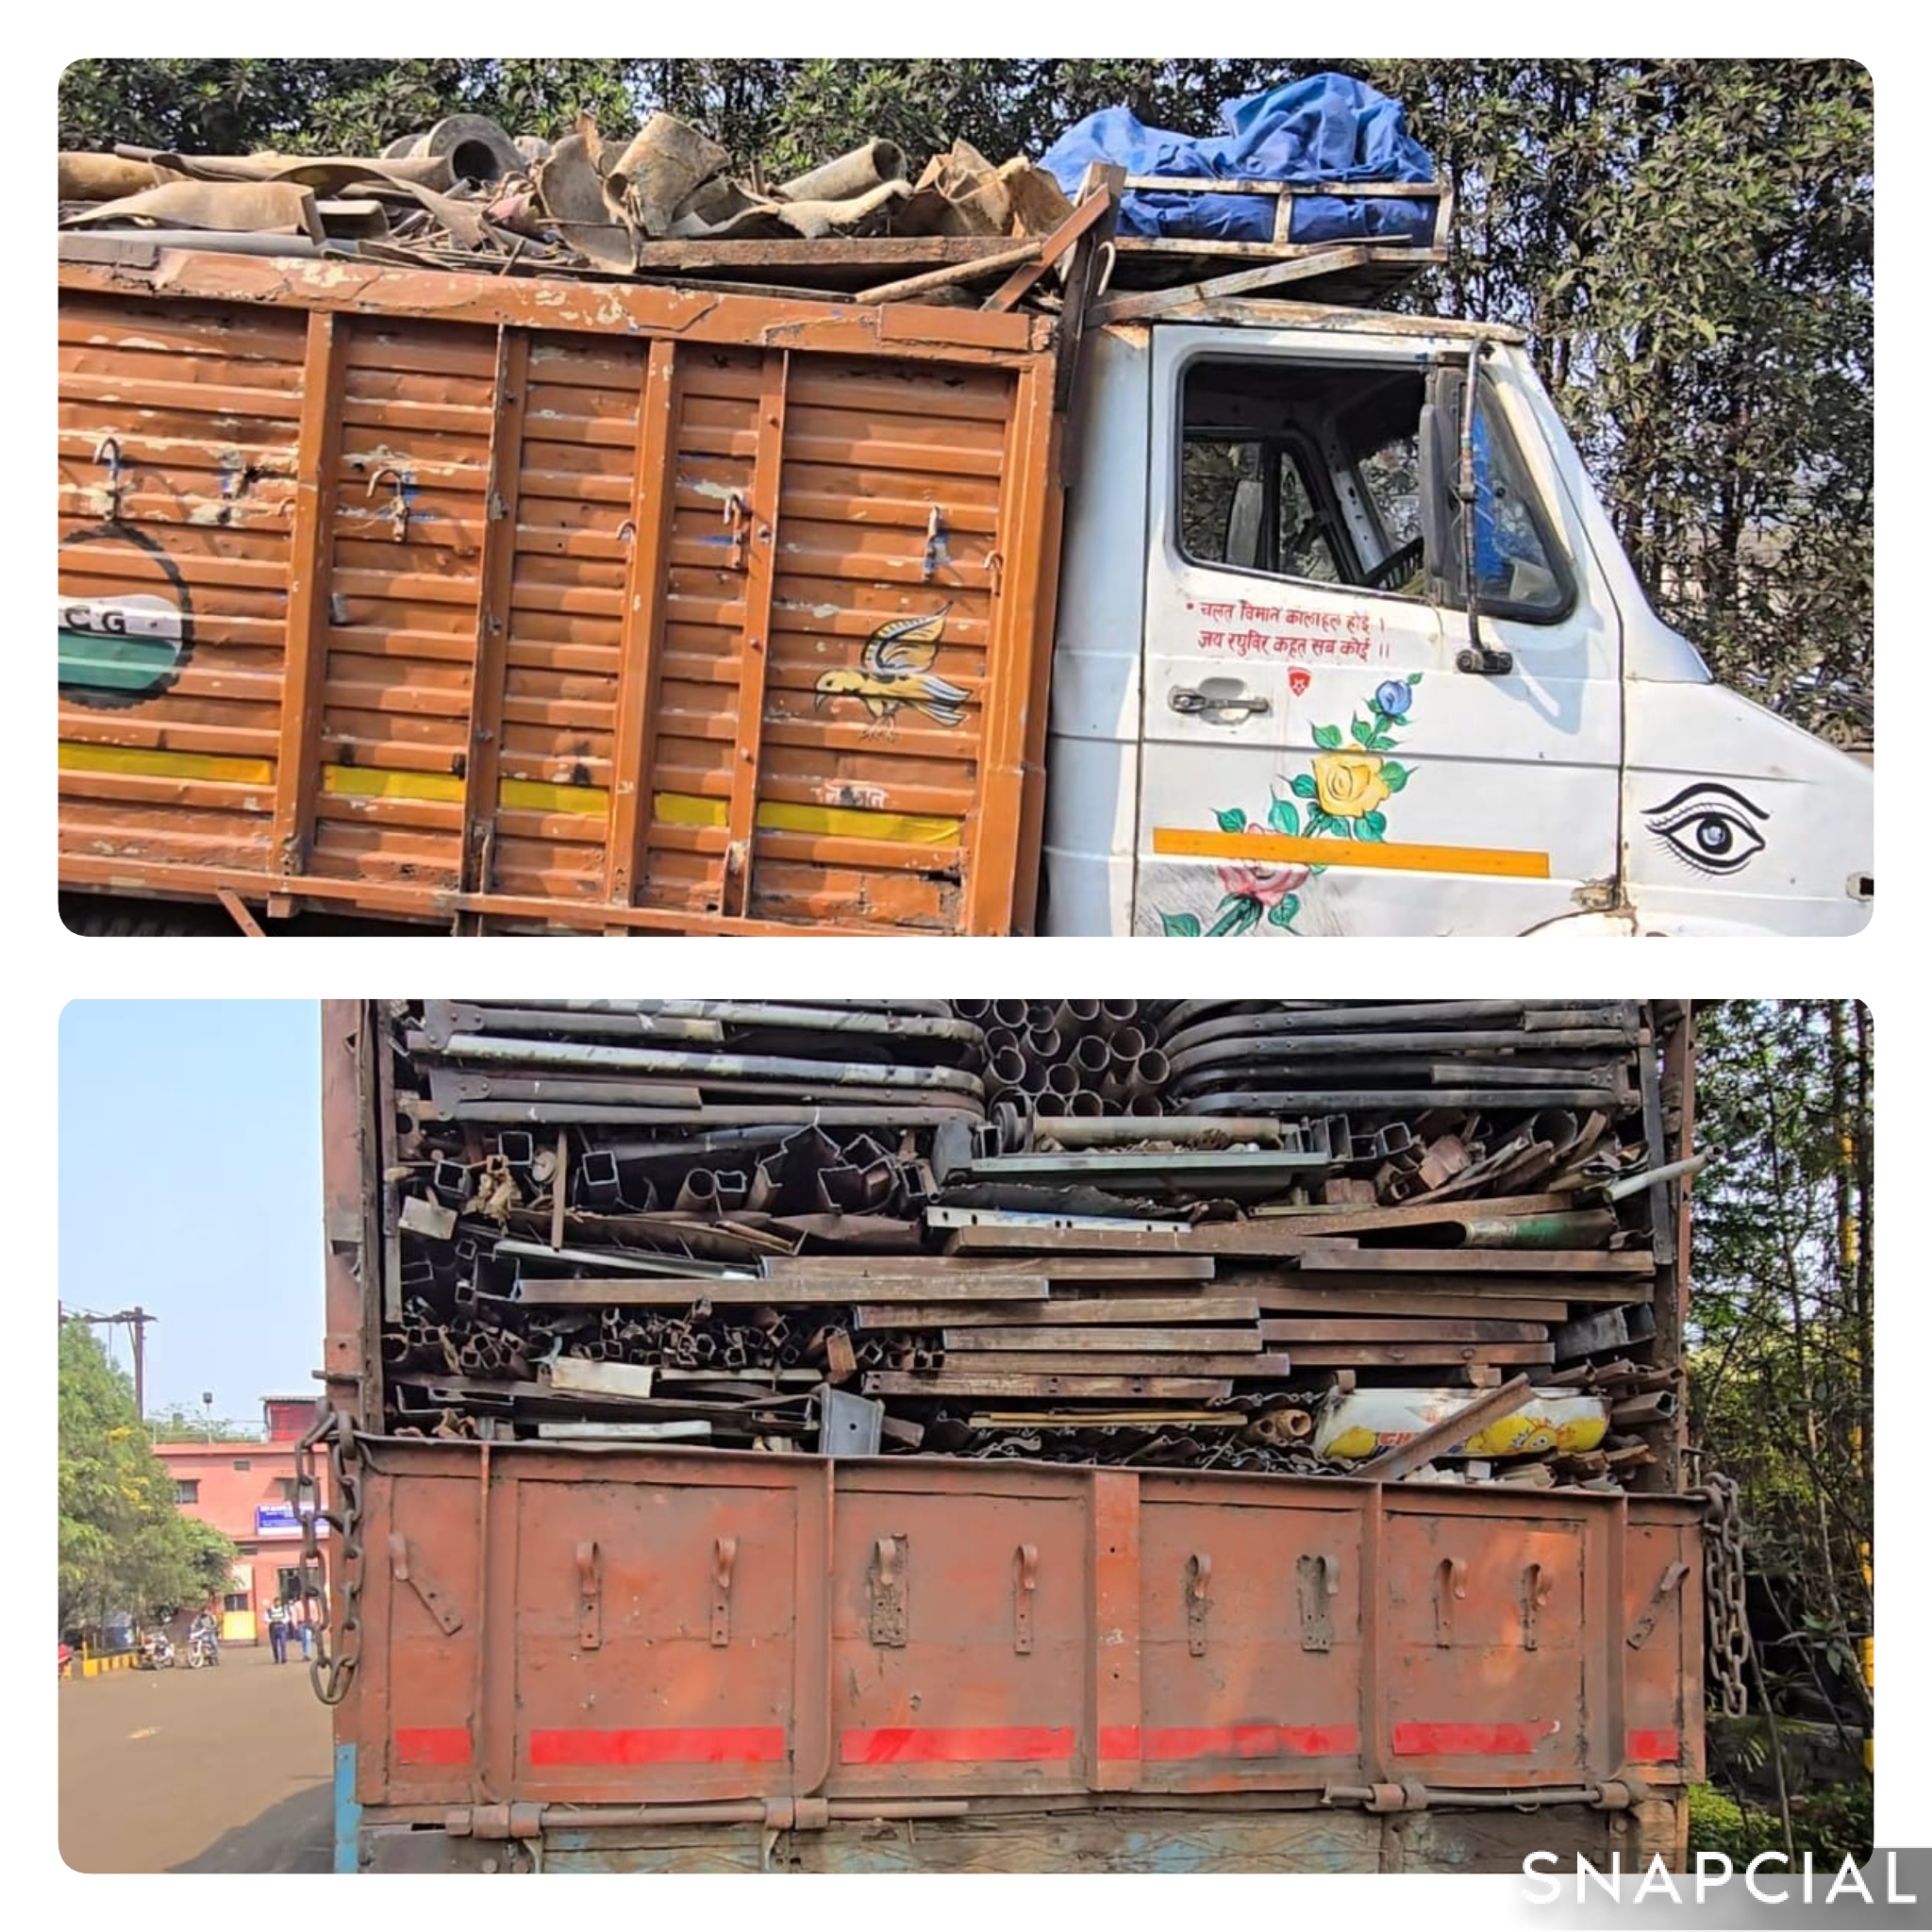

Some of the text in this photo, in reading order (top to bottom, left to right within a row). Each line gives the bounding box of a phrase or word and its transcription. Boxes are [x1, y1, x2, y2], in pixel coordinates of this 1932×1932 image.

[1199, 602, 1235, 623] चलत
[1198, 630, 1225, 648] जय
[1274, 636, 1307, 658] कहत
[1311, 639, 1337, 657] सब
[1341, 637, 1372, 662] कोई
